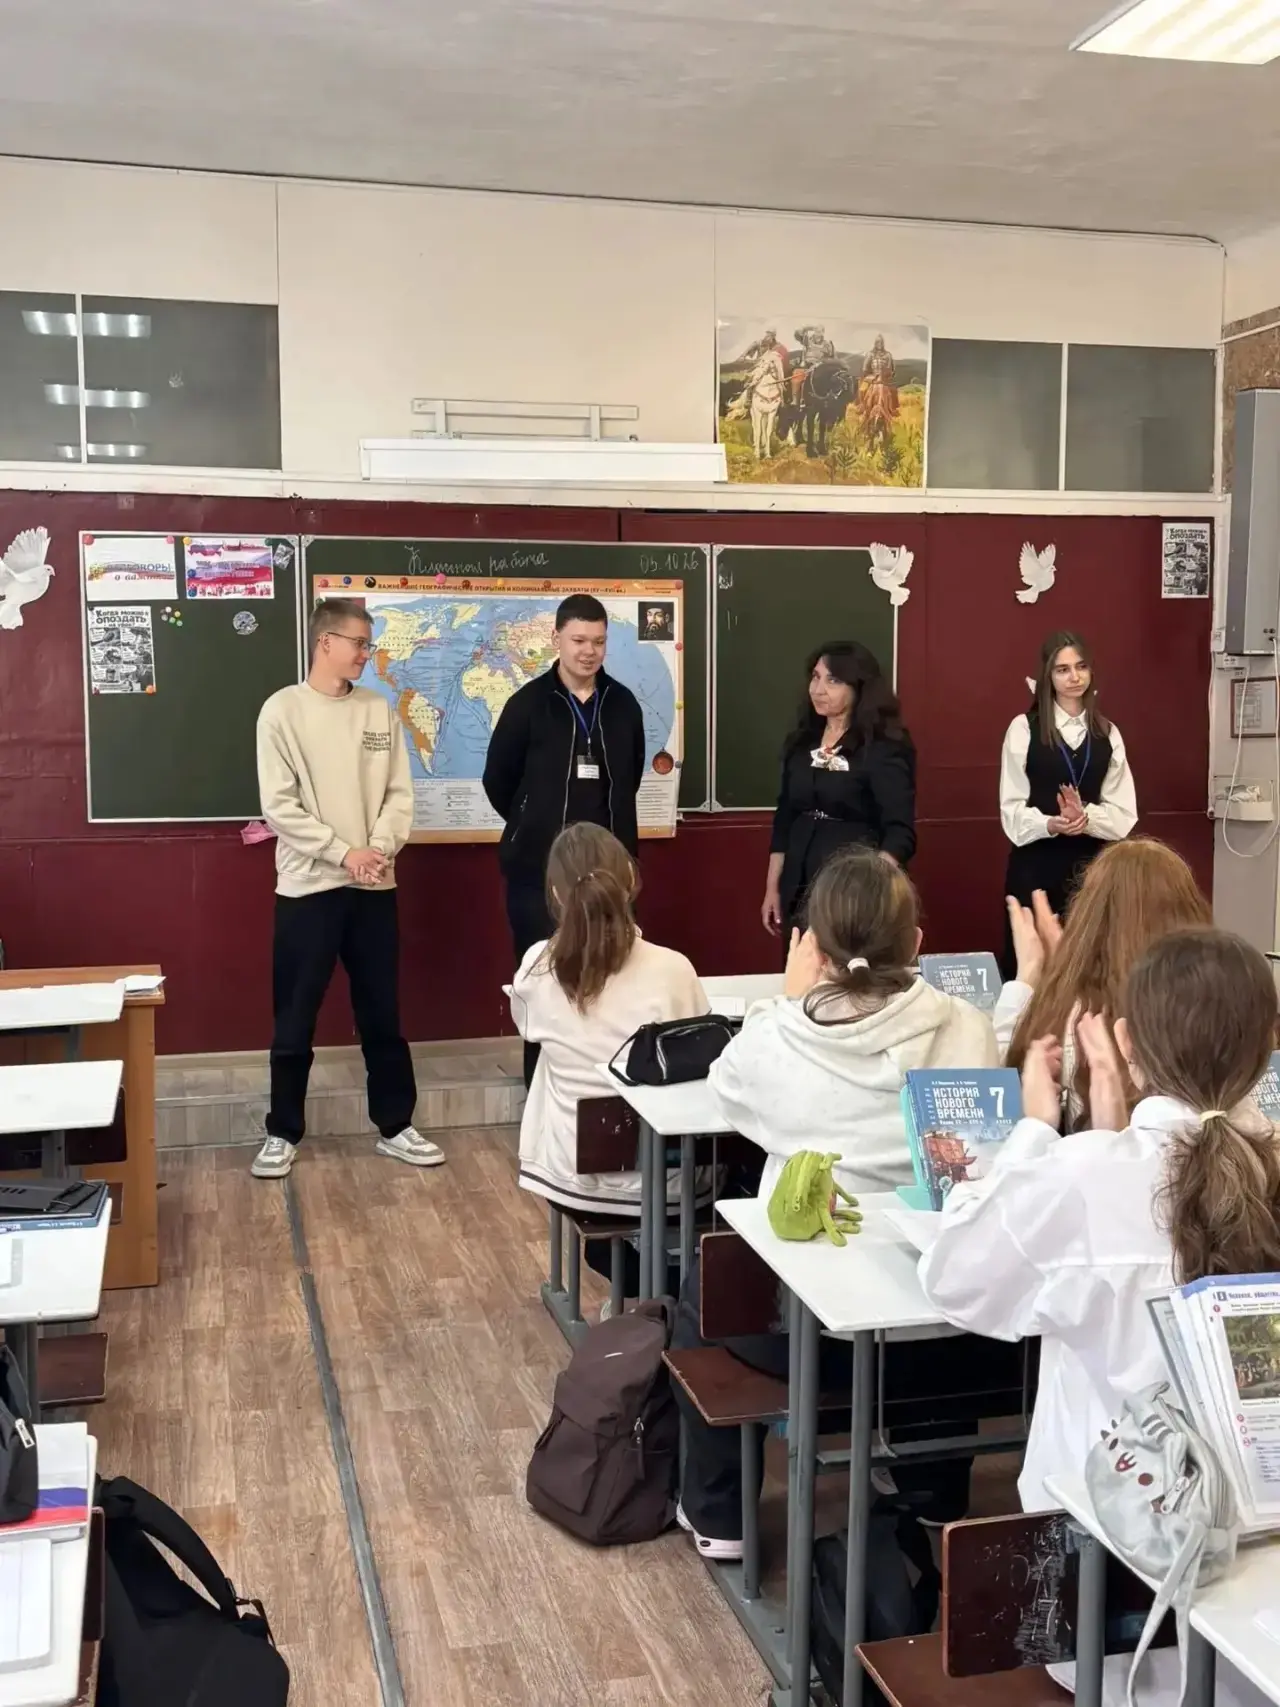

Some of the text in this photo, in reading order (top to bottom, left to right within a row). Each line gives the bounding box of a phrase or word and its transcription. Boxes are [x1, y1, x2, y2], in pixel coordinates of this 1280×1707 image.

[940, 967, 989, 992] ИСТОРИЯ 7
[941, 977, 969, 986] НОВОГО
[932, 1086, 1005, 1118] ИСТОРИЯ 7
[935, 1097, 975, 1109] НОВОГО
[937, 1107, 985, 1120] ВРЕМЕНИ
